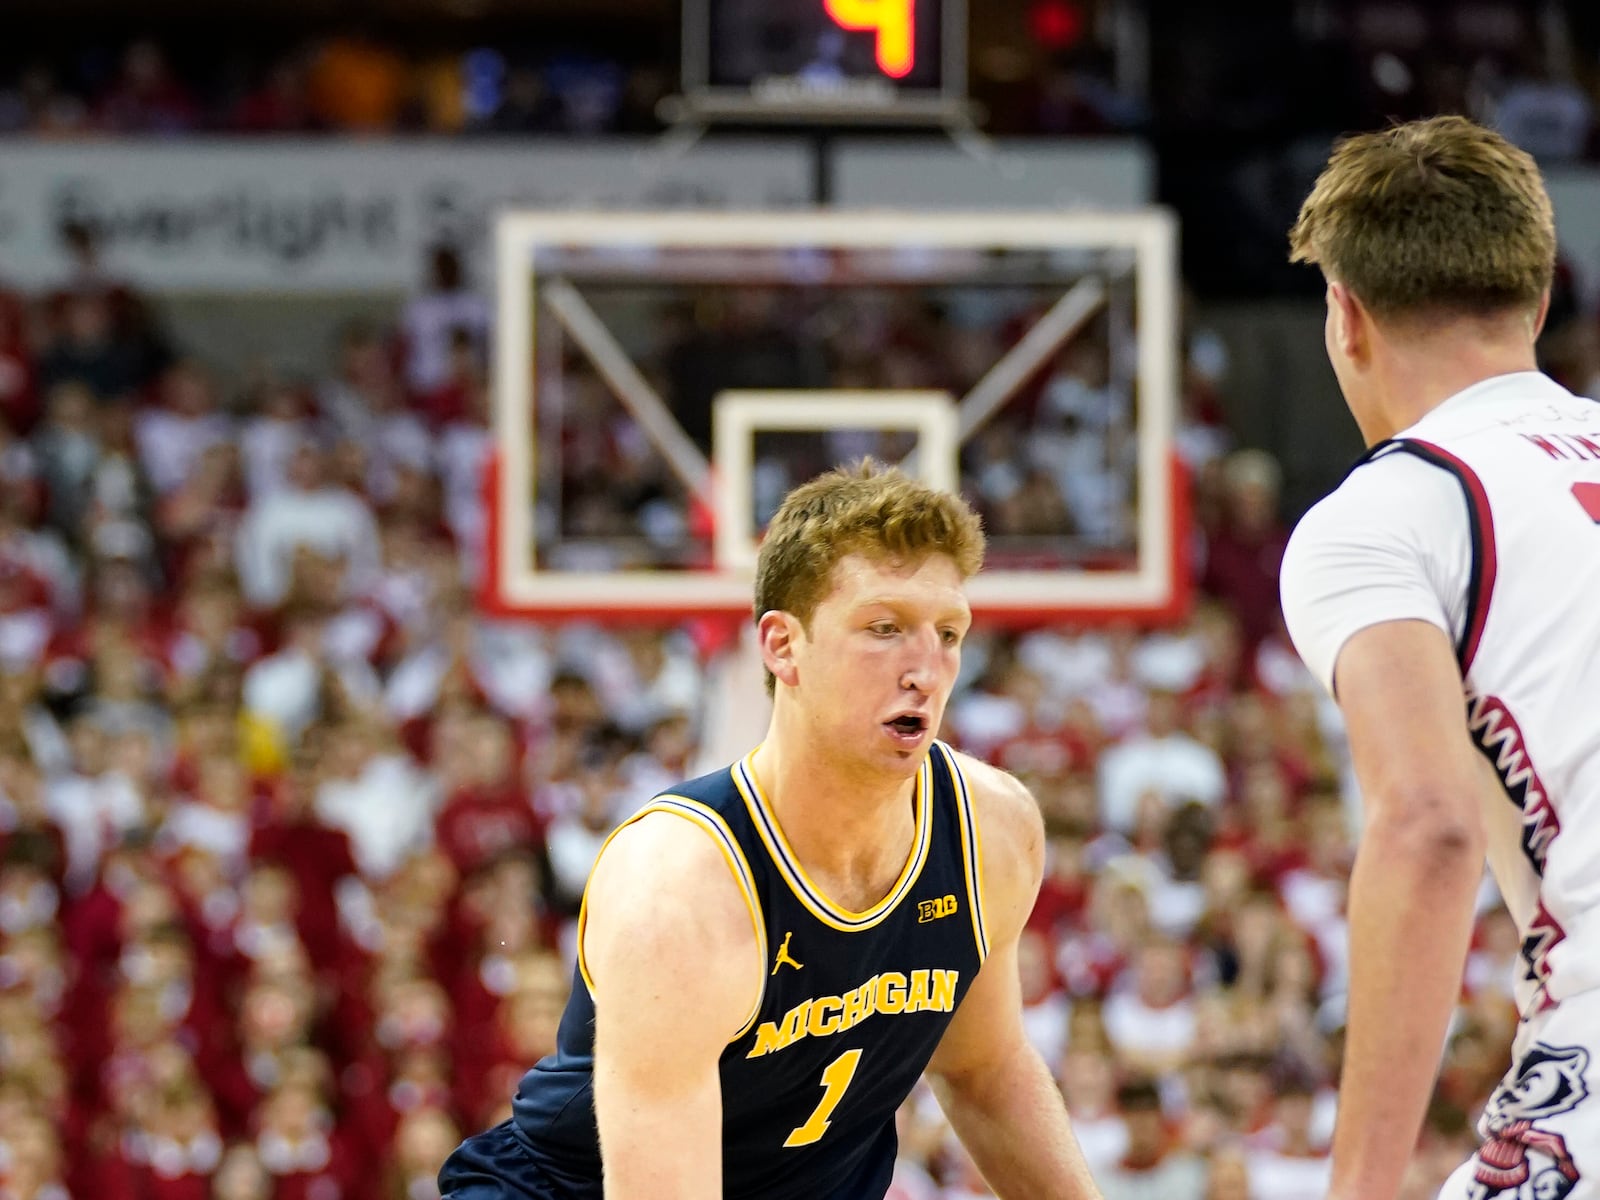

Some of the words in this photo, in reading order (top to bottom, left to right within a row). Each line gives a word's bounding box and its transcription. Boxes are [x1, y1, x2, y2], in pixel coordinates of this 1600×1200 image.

[1516, 432, 1600, 461] WIN
[745, 968, 960, 1060] MICHIGAN
[782, 1048, 864, 1148] 1
